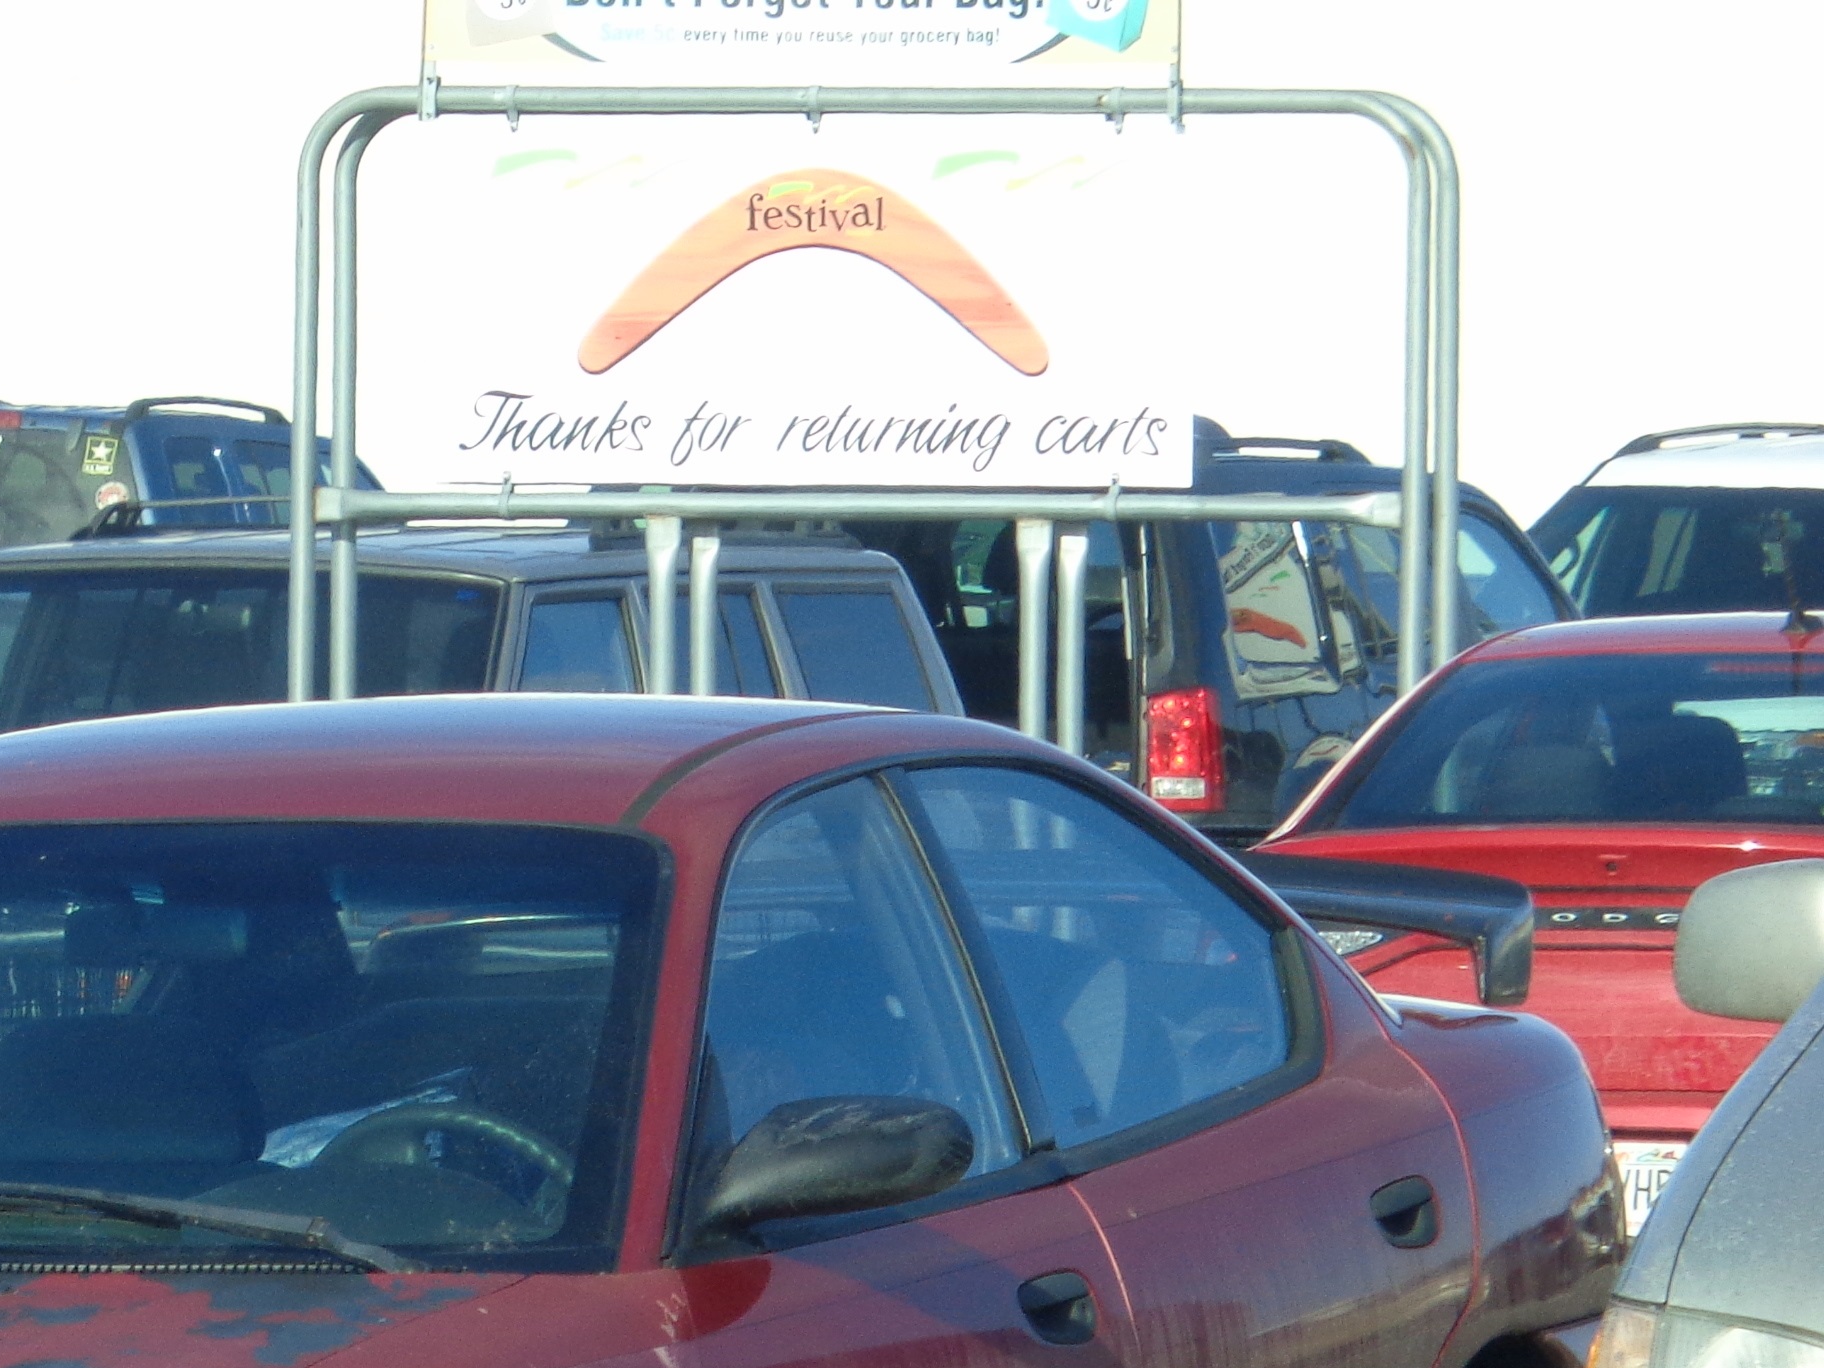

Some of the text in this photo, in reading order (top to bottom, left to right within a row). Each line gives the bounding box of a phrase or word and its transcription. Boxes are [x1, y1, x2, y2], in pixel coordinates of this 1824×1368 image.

[683, 29, 726, 44] every
[734, 27, 768, 42] time
[776, 30, 802, 45] you
[809, 30, 853, 43] reuse
[860, 31, 894, 46] your
[900, 30, 960, 47] grocery
[966, 27, 1000, 46] bag!
[745, 193, 884, 232] festival
[459, 390, 1167, 472] Thanks for returning carts
